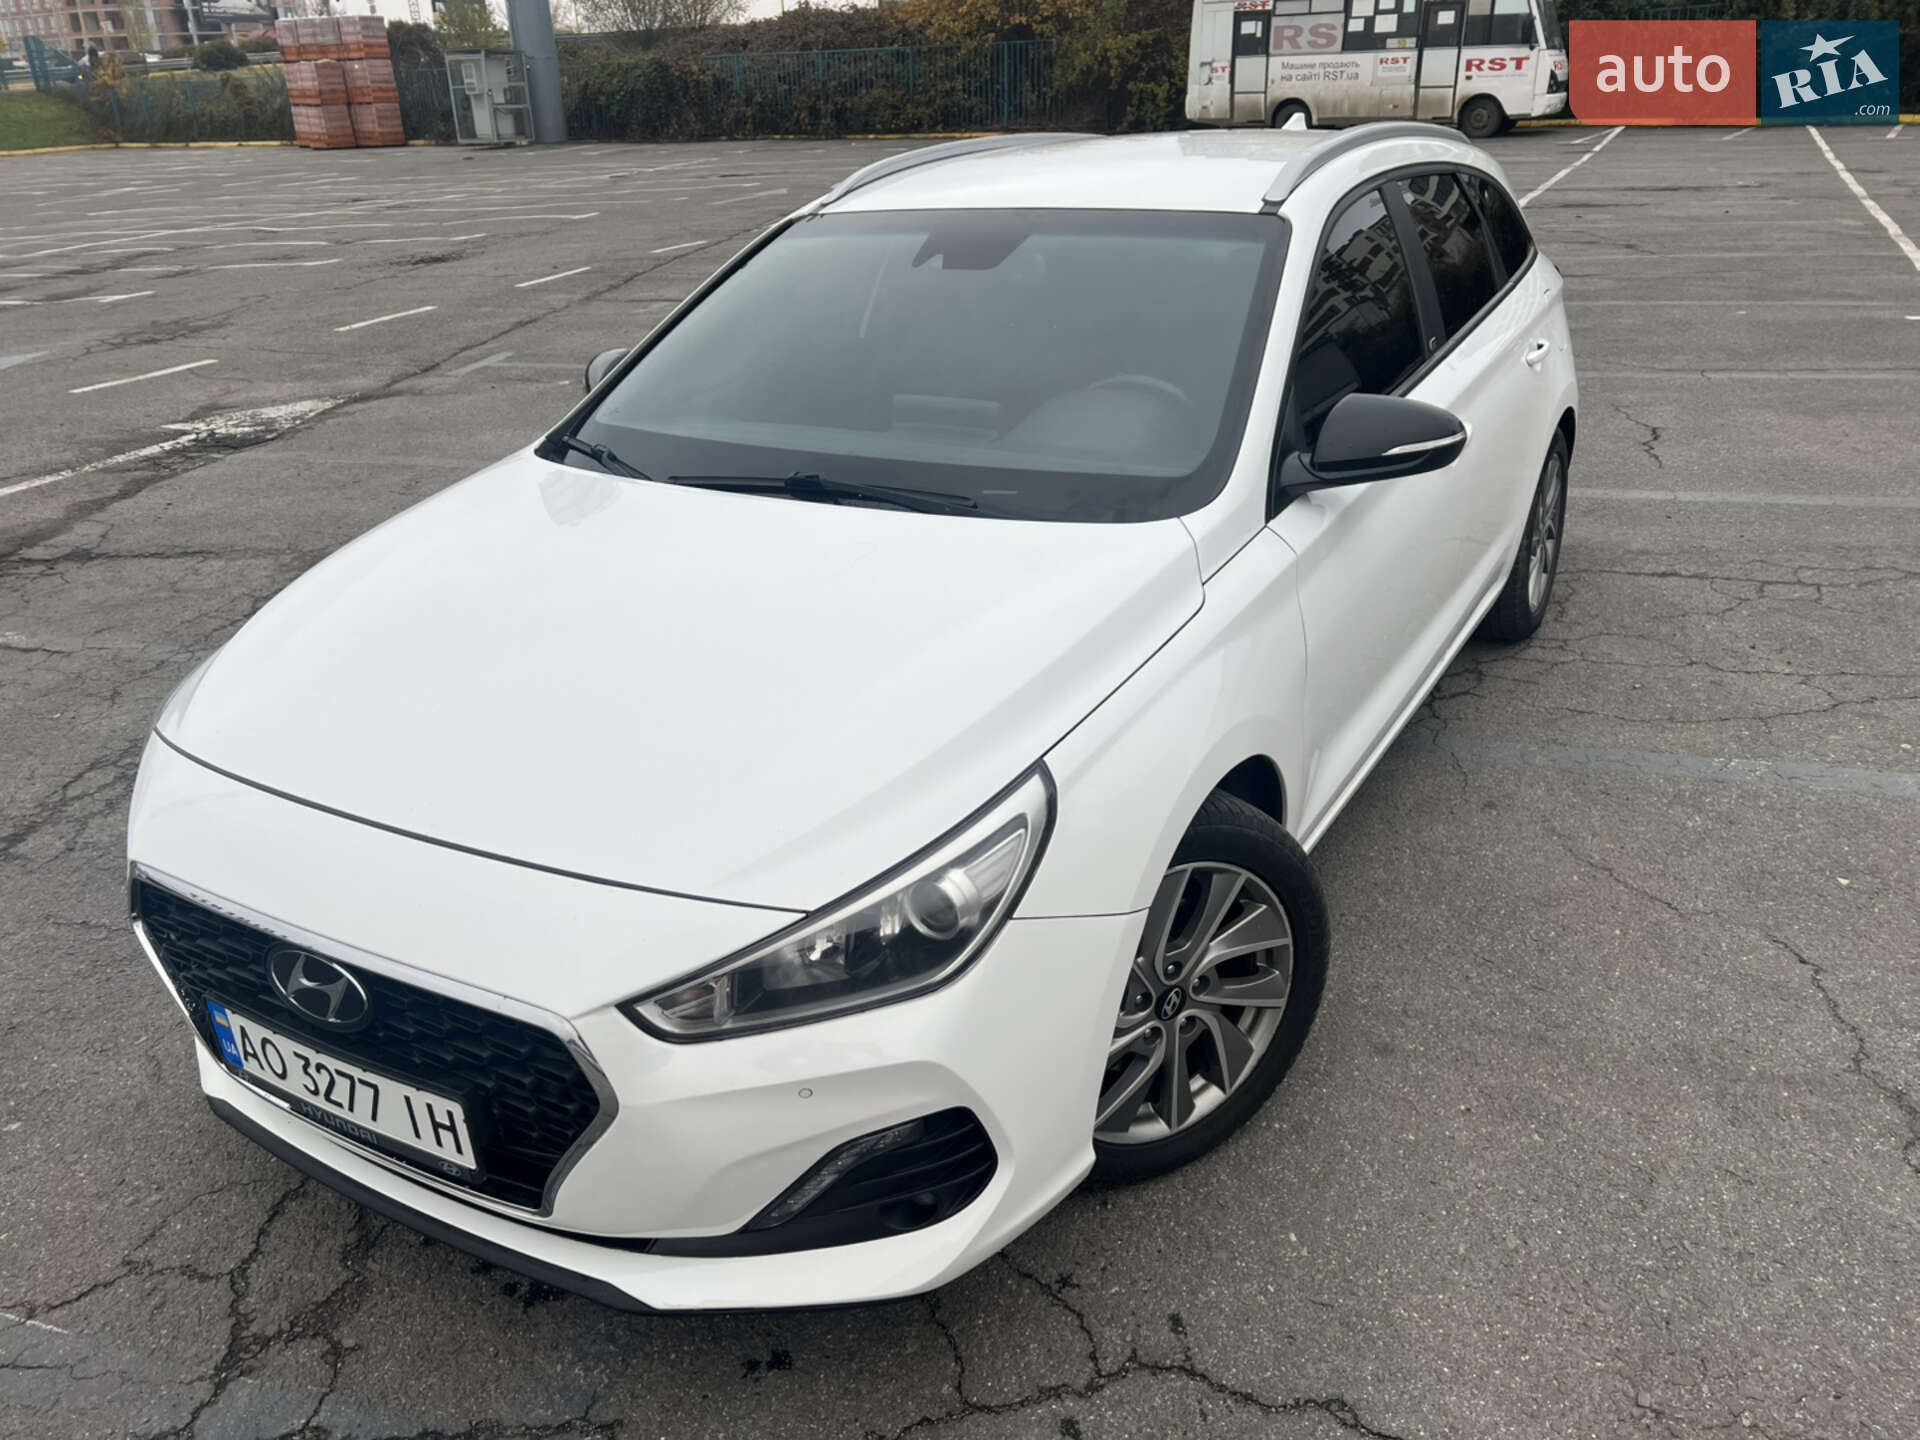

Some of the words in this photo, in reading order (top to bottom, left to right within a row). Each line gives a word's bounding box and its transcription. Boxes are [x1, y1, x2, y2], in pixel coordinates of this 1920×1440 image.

[1272, 23, 1338, 51] RS
[1379, 56, 1411, 65] RST
[1465, 56, 1530, 72] RST
[1280, 73, 1293, 82] на
[1323, 70, 1360, 81] RST.ua
[222, 1039, 238, 1057] UA
[239, 1024, 288, 1081] AO
[293, 1051, 380, 1122] 3277
[404, 1094, 464, 1156] IH
